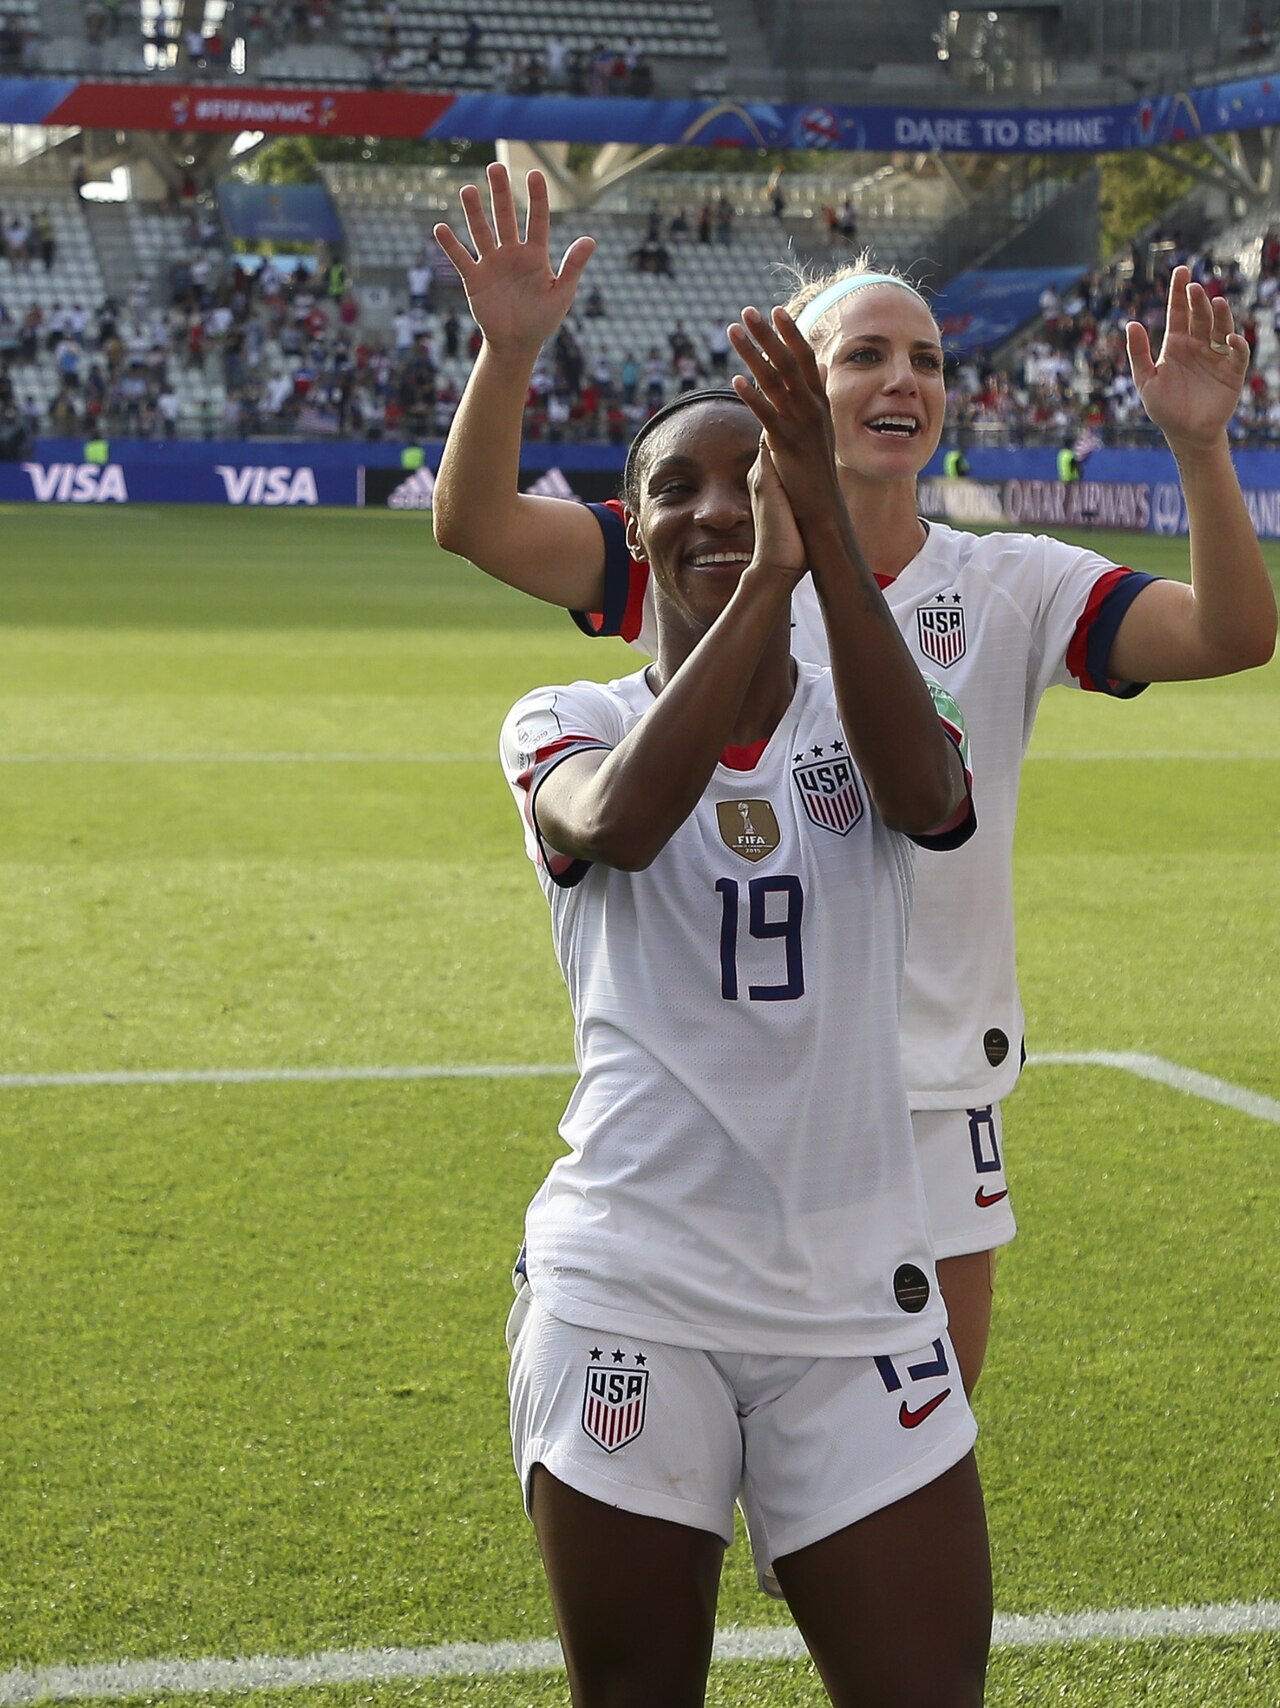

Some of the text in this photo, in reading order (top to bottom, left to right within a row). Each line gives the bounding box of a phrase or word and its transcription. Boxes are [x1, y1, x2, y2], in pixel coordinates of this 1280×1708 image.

[895, 116, 1106, 147] DARE TO SHINE
[21, 463, 128, 503] VISA
[214, 464, 319, 505] VISA
[1003, 478, 1066, 524] QATAR
[921, 611, 961, 634] USA
[800, 763, 850, 794] USA
[737, 835, 766, 845] FIFA
[714, 874, 805, 1001] 19
[965, 1104, 1002, 1174] 8
[591, 1372, 643, 1404] USA
